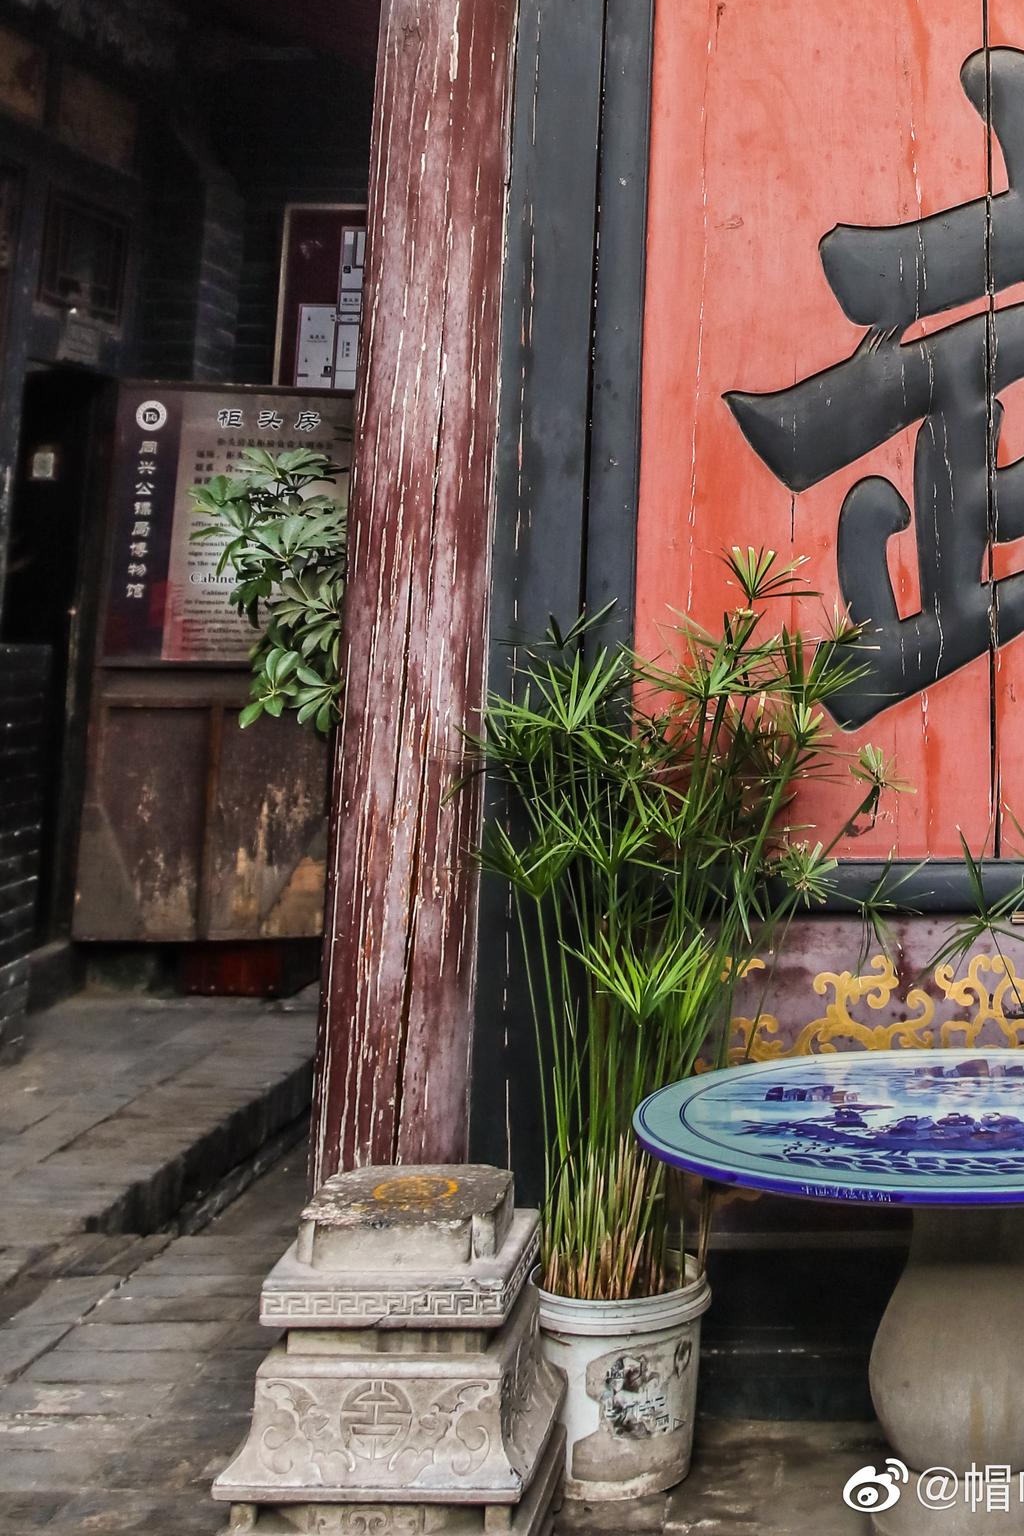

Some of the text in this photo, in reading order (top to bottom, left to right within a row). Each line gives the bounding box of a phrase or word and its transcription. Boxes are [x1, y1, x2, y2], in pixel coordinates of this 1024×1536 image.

[217, 408, 322, 432] 柜头房
[126, 440, 158, 599] 同兴公镖局博物馆
[190, 573, 239, 584] Cabinet
